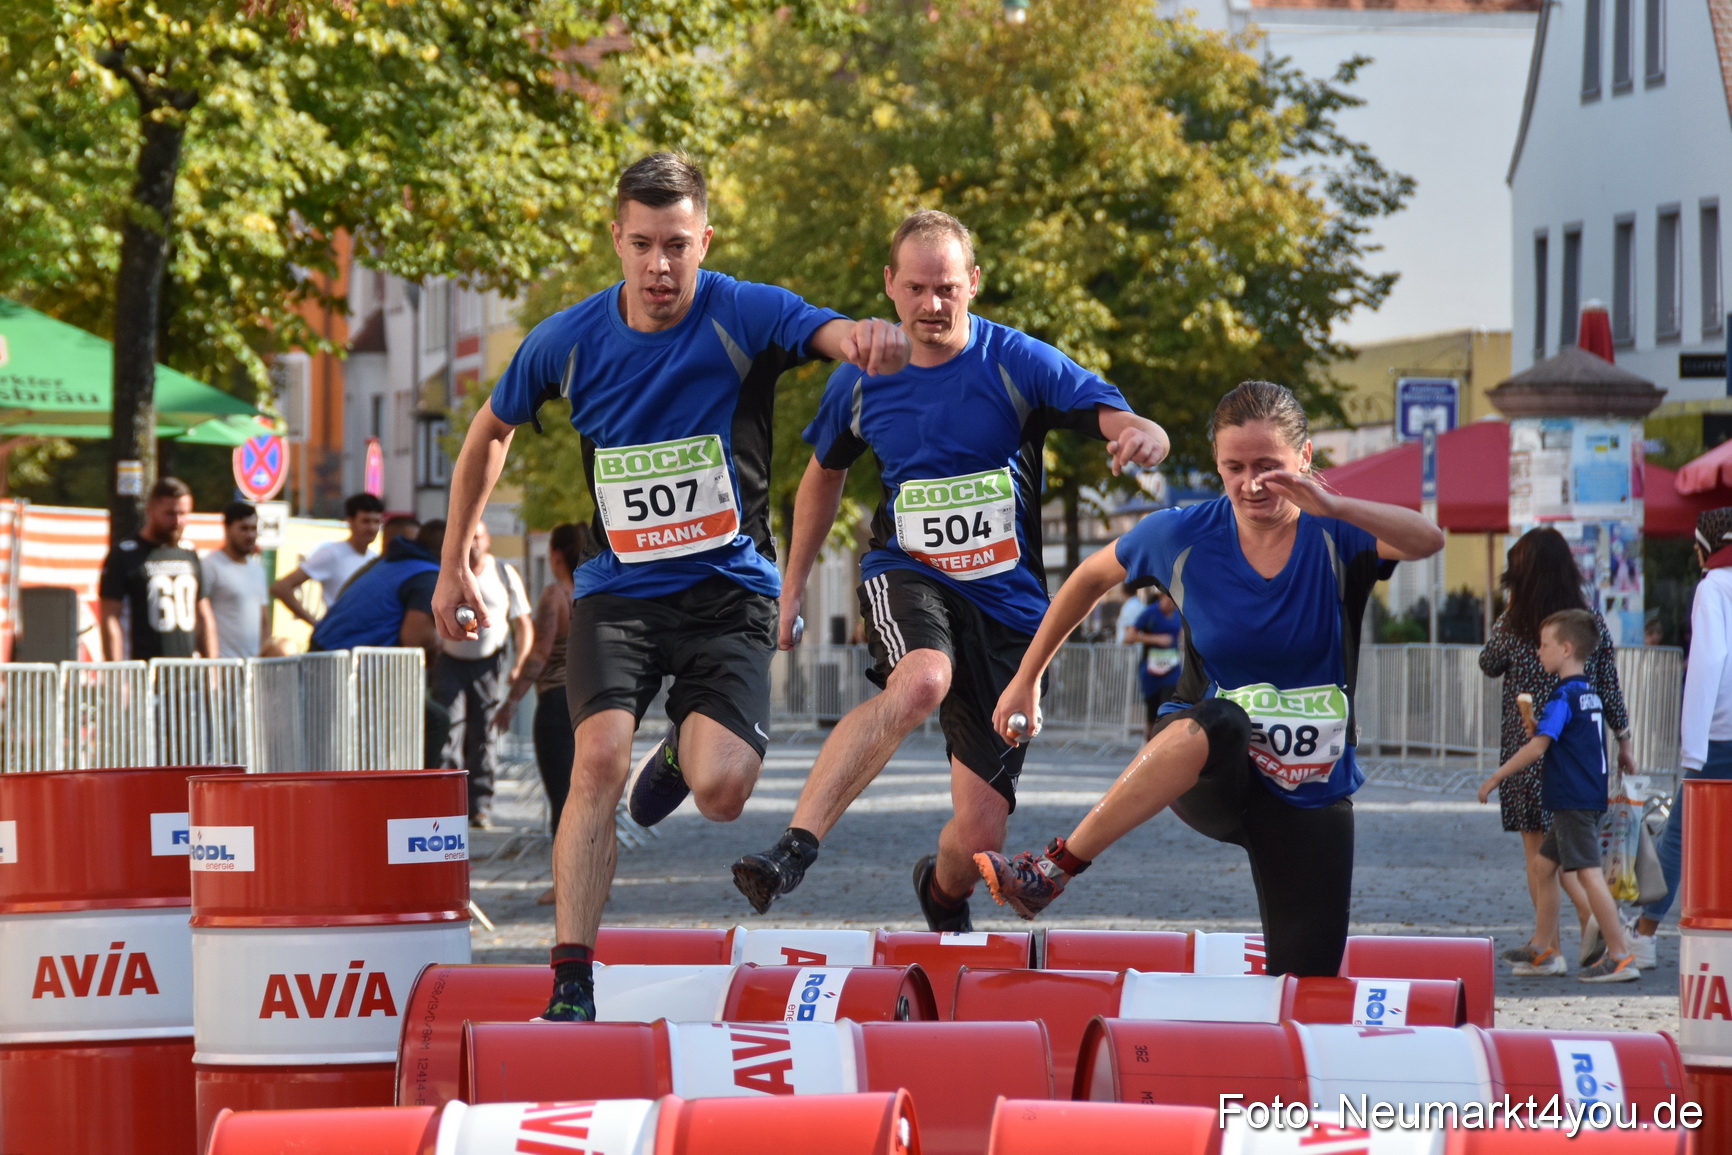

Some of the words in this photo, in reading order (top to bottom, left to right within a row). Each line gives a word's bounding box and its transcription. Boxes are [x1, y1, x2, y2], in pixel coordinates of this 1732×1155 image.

[598, 440, 713, 479] BOCK
[623, 478, 698, 522] 507
[903, 474, 1004, 509] BOCK
[635, 522, 707, 548] FRANK
[922, 511, 992, 548] 504
[929, 548, 995, 569] STEFAN
[147, 573, 197, 633] 60
[1226, 688, 1338, 717] BOCK
[1251, 722, 1320, 757] 508
[205, 858, 235, 870] energie
